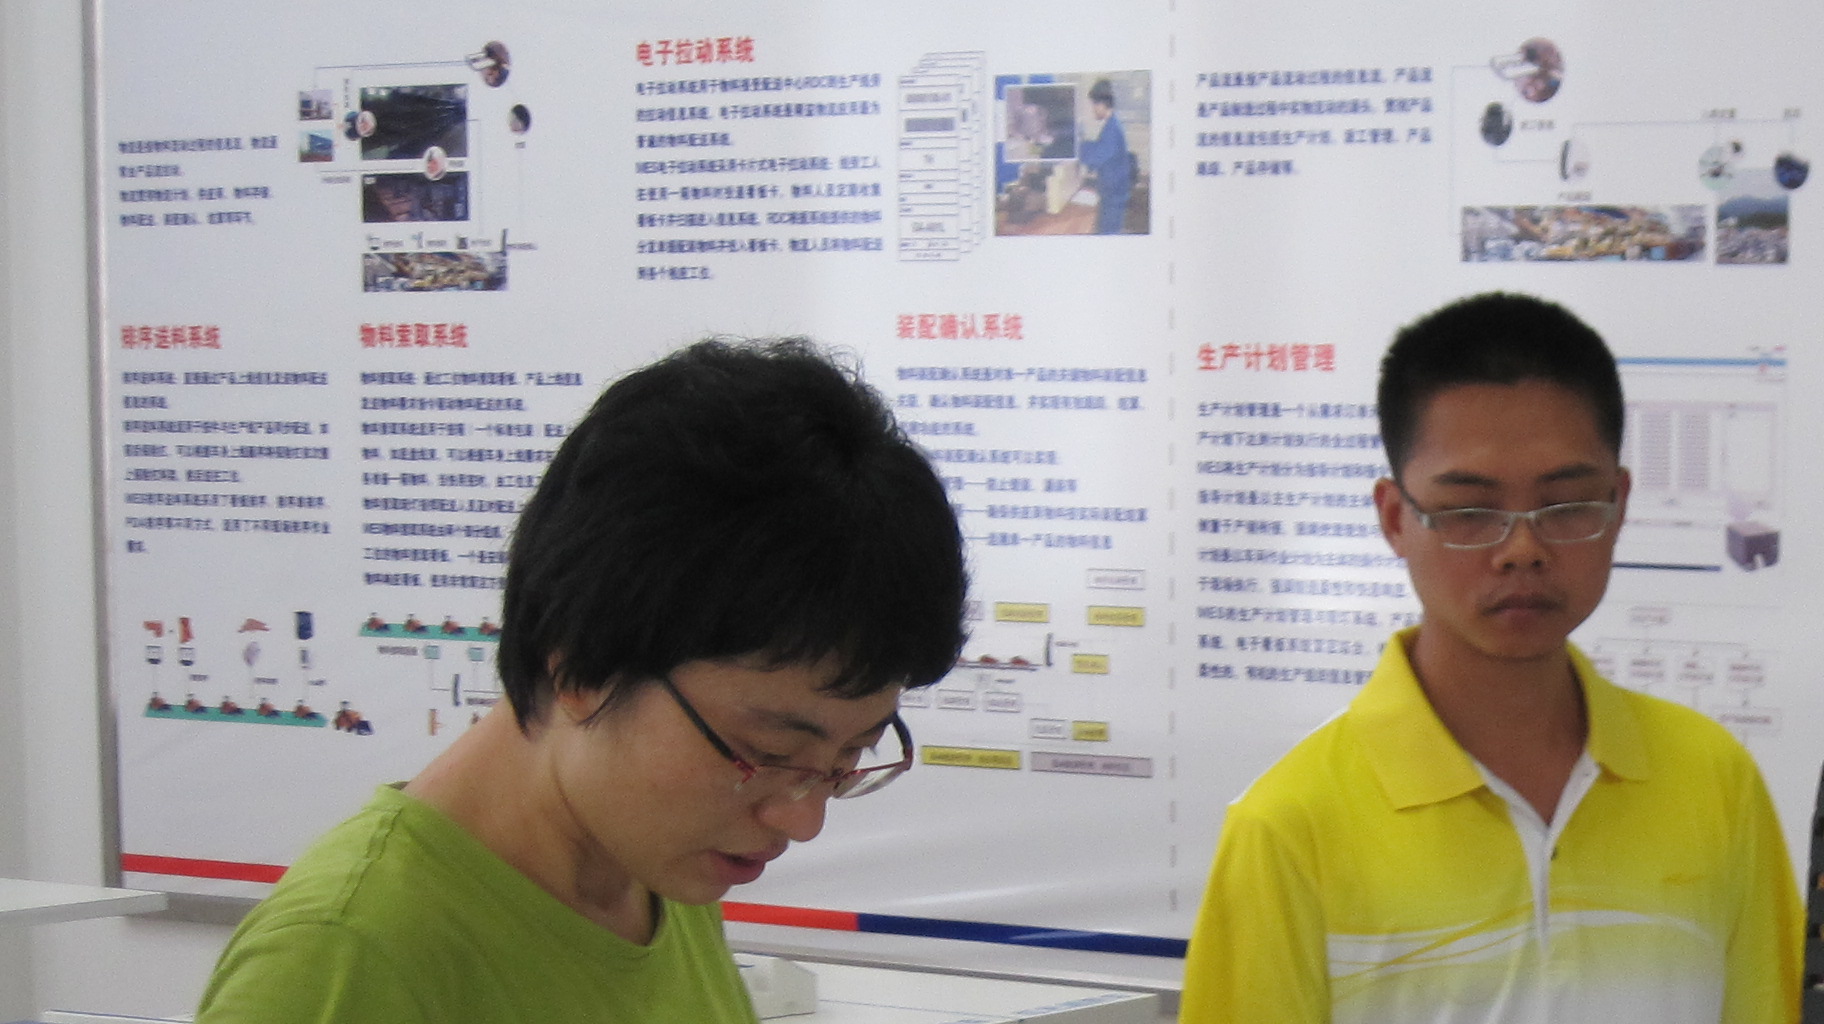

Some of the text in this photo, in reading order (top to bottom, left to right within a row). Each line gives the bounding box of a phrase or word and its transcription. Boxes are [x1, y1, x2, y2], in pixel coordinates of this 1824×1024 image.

[636, 36, 755, 67] 电子拉动系统
[360, 323, 469, 348] 物料索取系统
[898, 313, 1024, 340] 装配确认系统
[1197, 343, 1336, 372] 生产计划管理
